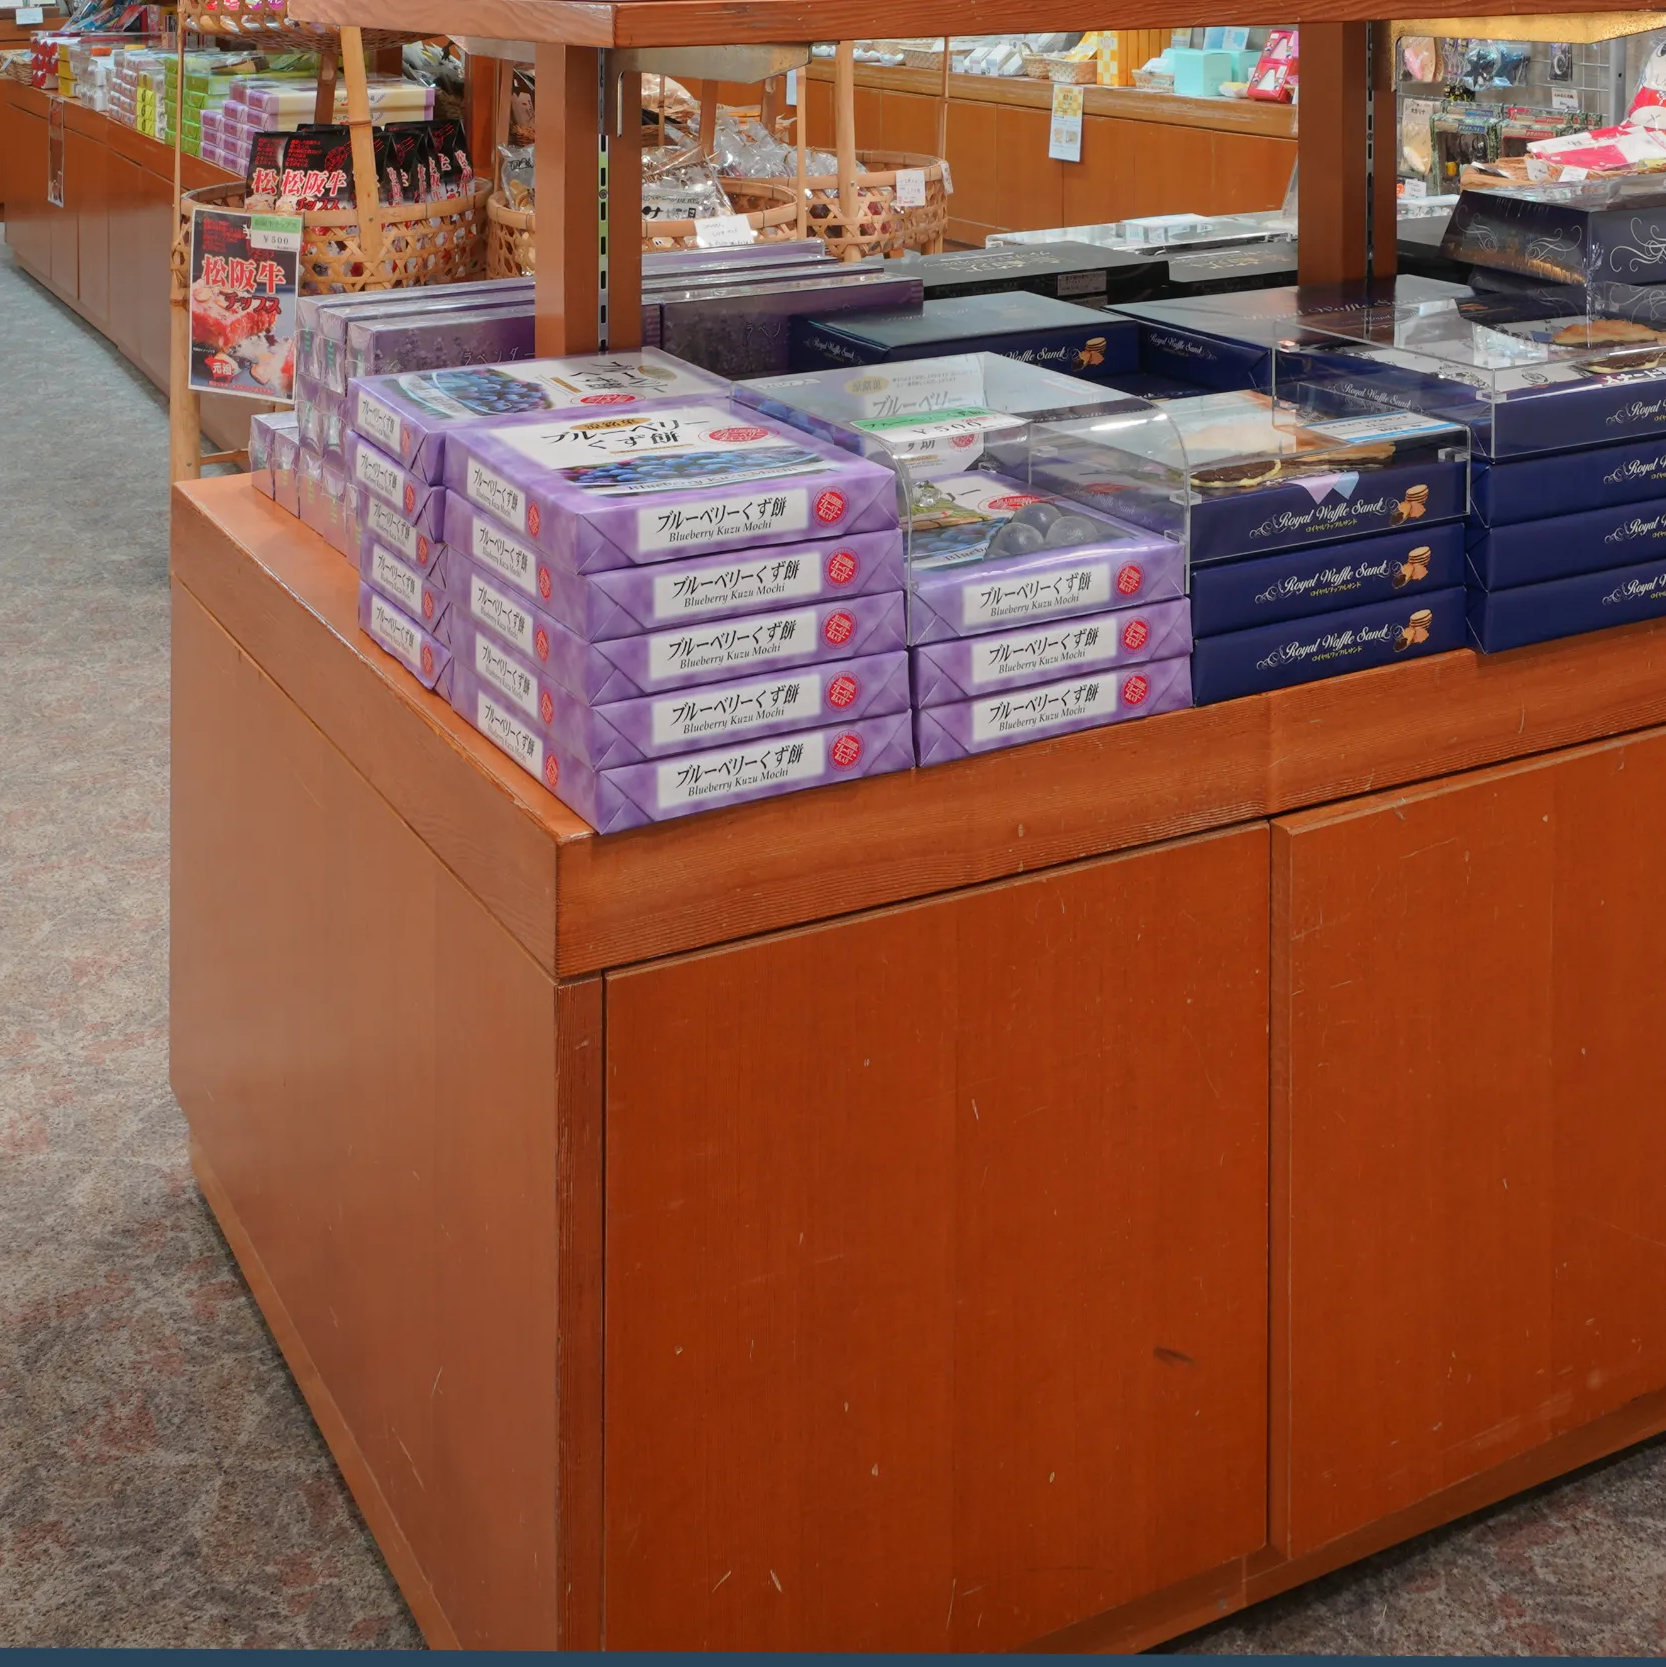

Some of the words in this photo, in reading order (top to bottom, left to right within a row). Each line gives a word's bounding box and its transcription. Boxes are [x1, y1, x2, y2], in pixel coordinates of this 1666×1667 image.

[281, 168, 347, 198] 松阪牛
[201, 253, 286, 294] 松阪牛
[1628, 400, 1660, 418] Royal
[541, 418, 710, 444] ブルーベリー
[586, 431, 681, 450] くず餅
[1625, 459, 1657, 477] Royal
[473, 468, 519, 512] ブルーベリーくず餅
[658, 496, 787, 533] ブルーベリーくず餅
[1274, 510, 1314, 530] Royal
[1316, 502, 1350, 523] Waffle
[1626, 517, 1657, 535] Royal
[669, 526, 714, 542] Blueberry
[716, 523, 741, 536] Kuzu
[742, 519, 772, 532] Mochi
[479, 527, 528, 573] ブルーベリーくず餅
[671, 559, 801, 599] ブルーベリーくず餅
[980, 571, 1092, 609] ブルーベリーくず餅
[1279, 573, 1319, 593] Royal
[1320, 566, 1354, 587] Waffle
[1623, 578, 1656, 597] Royal
[684, 592, 728, 608] Blueberry
[730, 588, 754, 600] Kuzu
[756, 583, 786, 596] Mochi
[990, 603, 1029, 617] Blueberry
[1031, 599, 1052, 610] Kuzu
[1054, 593, 1080, 607] Mochi
[477, 586, 525, 635] ブルーベリーくず餅
[667, 619, 797, 660] ブルーベリーくず餅
[988, 627, 1099, 667] ブルーベリーくず餅
[1281, 638, 1319, 658] Royal
[1321, 630, 1355, 650] Waffle
[482, 645, 531, 696] ブルーベリーくず餅
[680, 653, 724, 669] Blueberry
[726, 649, 750, 661] Kuzu
[751, 643, 781, 657] Mochi
[998, 659, 1037, 674] Blueberry
[1038, 655, 1059, 666] Kuzu
[1060, 649, 1086, 662] Mochi
[670, 683, 800, 726] ブルーベリーくず餅
[988, 683, 1100, 724] ブルーベリーくず餅
[484, 704, 535, 758] ブルーベリーくず餅
[683, 718, 728, 734] Blueberry
[729, 714, 754, 726] Kuzu
[755, 708, 785, 722] Mochi
[999, 717, 1037, 731] Blueberry
[1038, 712, 1059, 723] Kuzu
[1060, 706, 1086, 719] Mochi
[676, 743, 804, 789] ブルーベリーくず餅
[688, 780, 732, 797] Blueberry
[734, 776, 758, 788] Kuzu
[760, 766, 789, 782] Mochi
